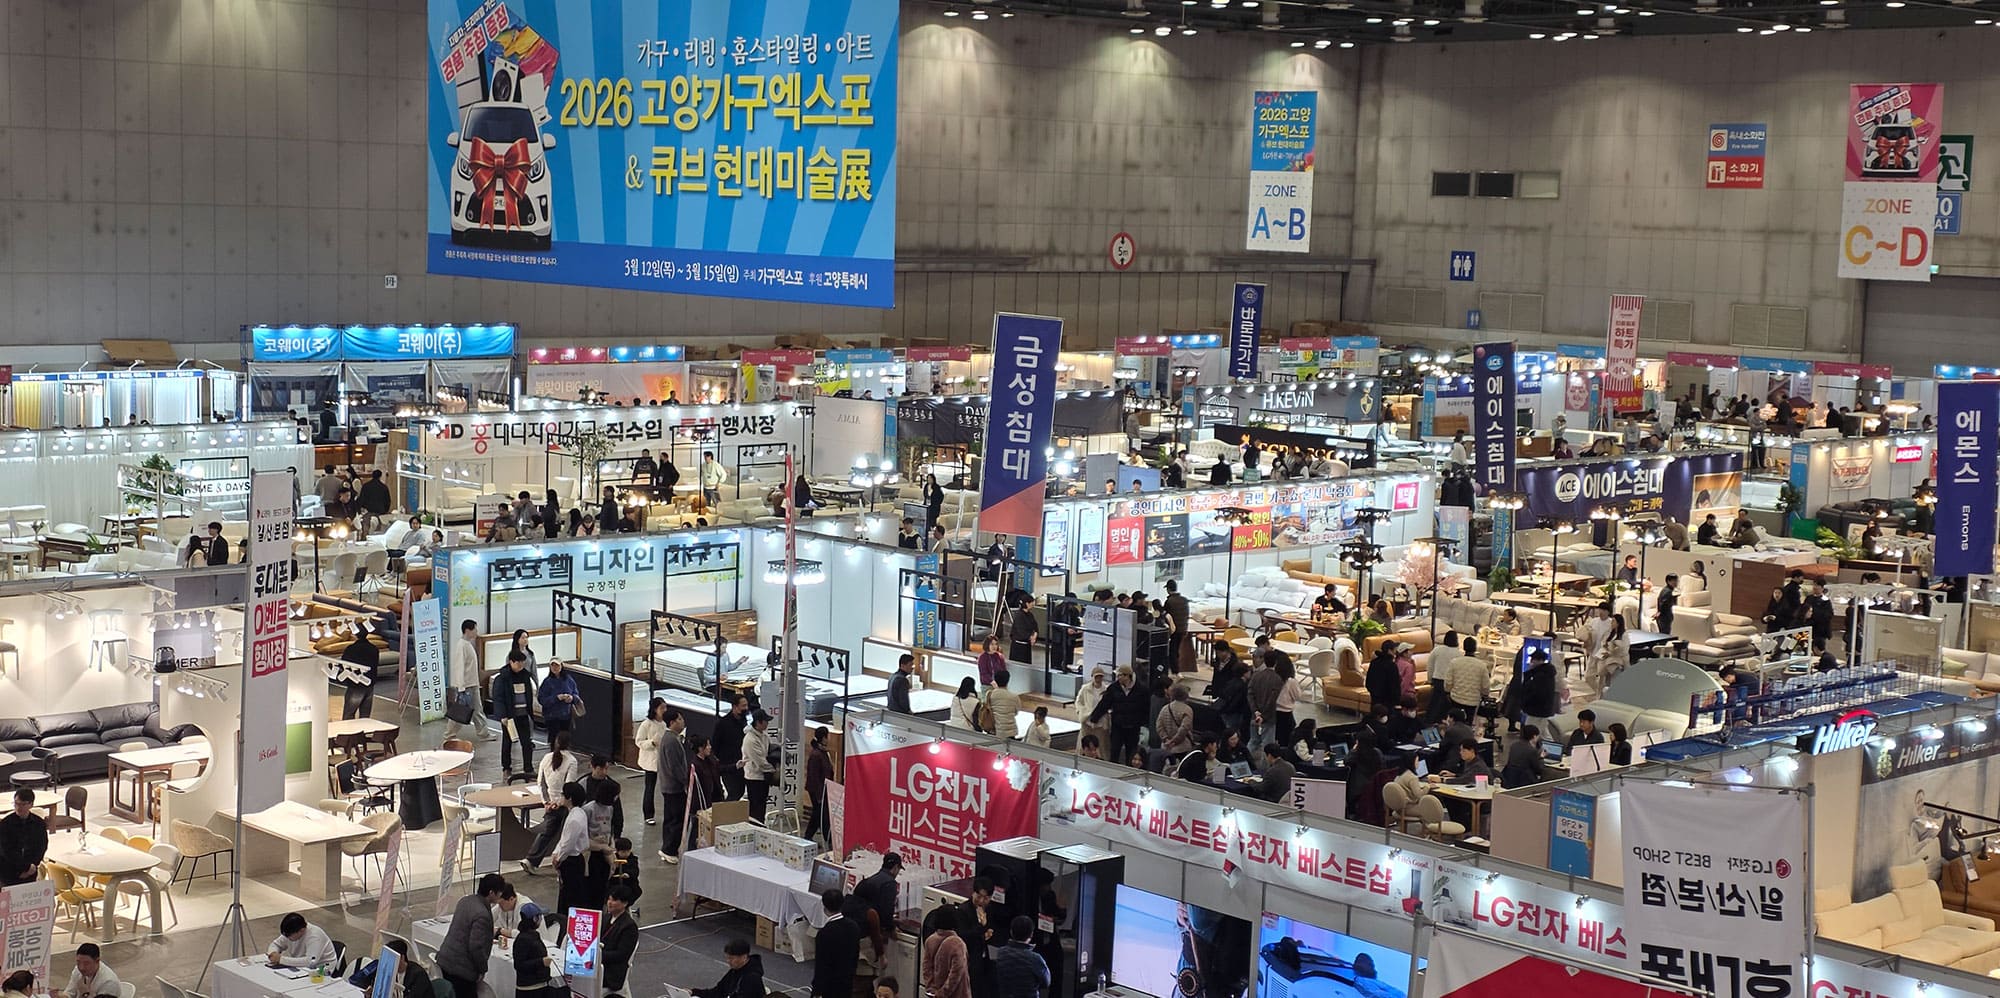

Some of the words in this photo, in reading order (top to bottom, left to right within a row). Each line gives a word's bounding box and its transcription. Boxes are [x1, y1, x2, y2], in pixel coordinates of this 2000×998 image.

[441, 48, 465, 84] 경품
[462, 24, 488, 59] 추첨
[485, 2, 509, 41] 증정
[637, 40, 669, 69] 가구
[684, 37, 715, 68] 리빙
[731, 34, 819, 67] 홈스타일링
[836, 32, 874, 63] 아트
[561, 77, 633, 127] 2026
[639, 73, 874, 132] 고양가구엑스포
[1260, 108, 1288, 121] 2026
[1289, 107, 1312, 123] 고양
[1259, 124, 1310, 139] 가구엑스포
[625, 155, 644, 190] &
[649, 145, 707, 196] 큐브
[714, 146, 872, 202] 현대미술展
[1264, 185, 1297, 198] ZONE
[1864, 199, 1912, 214] ZONE
[1251, 207, 1306, 241] A~B
[1844, 225, 1928, 267] C~D
[624, 258, 639, 276] 3월
[641, 258, 676, 279] 12일(목)
[686, 263, 701, 281] 3월
[704, 264, 740, 284] 15일(일)
[758, 269, 804, 287] 가구엑스포
[824, 271, 869, 291] 고양특례시
[264, 337, 331, 353] 코웨이(주)
[398, 331, 462, 355] 코웨이(주)
[1237, 306, 1257, 376] 바로크가구
[1614, 339, 1634, 349] 특가
[1615, 328, 1635, 338] 하트
[1002, 335, 1043, 481] 금성침대
[606, 419, 662, 442] 직수입
[722, 415, 776, 436] 행사장
[1486, 375, 1505, 485] 에이스침대
[1954, 410, 1981, 484] 에몬스
[225, 481, 251, 492] DAYS
[1560, 480, 1576, 493] ACE
[1583, 468, 1665, 500] 에이스침대
[1111, 527, 1130, 543] 명인
[1961, 505, 1971, 552] Emons
[584, 546, 655, 575] 디자인
[586, 579, 627, 593] 공장직영
[254, 599, 288, 636] 이벤트
[254, 638, 285, 673] 행사장
[1812, 721, 1878, 756] Hilker
[1897, 744, 1940, 769] Hilker
[889, 757, 990, 819] LG전자
[1071, 788, 1143, 832] LG전자
[1561, 818, 1577, 829] 9F2
[888, 799, 987, 857] 베스트샵
[1567, 830, 1583, 840] 9E2
[1297, 845, 1393, 896] 베스트샵
[1472, 889, 1570, 944] LG전자
